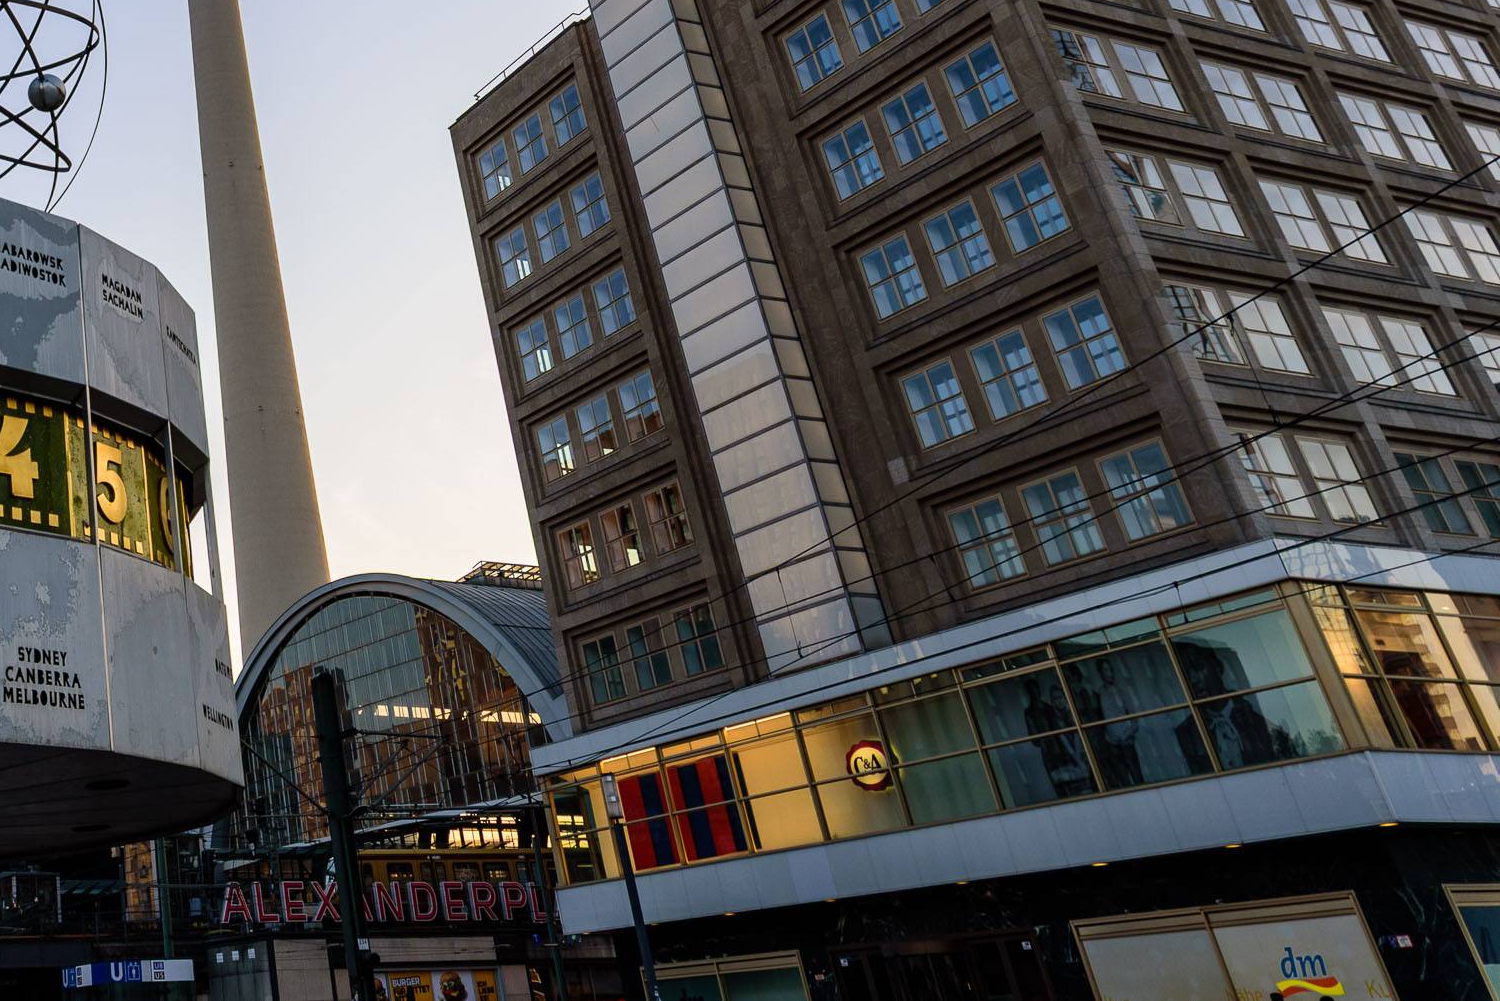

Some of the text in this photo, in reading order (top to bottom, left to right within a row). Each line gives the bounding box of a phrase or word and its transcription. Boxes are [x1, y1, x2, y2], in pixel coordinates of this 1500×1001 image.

[101, 272, 143, 305] MAGADAN
[102, 289, 144, 320] SACHALIN
[94, 439, 129, 524] 5
[17, 646, 68, 668] SYDNEY
[5, 665, 82, 690] CANBERRA
[2, 685, 86, 711] MELBOURNE
[853, 753, 882, 774] C&A
[221, 880, 548, 923] ALEXNDERPL
[110, 961, 124, 982] U
[1280, 946, 1327, 979] dm
